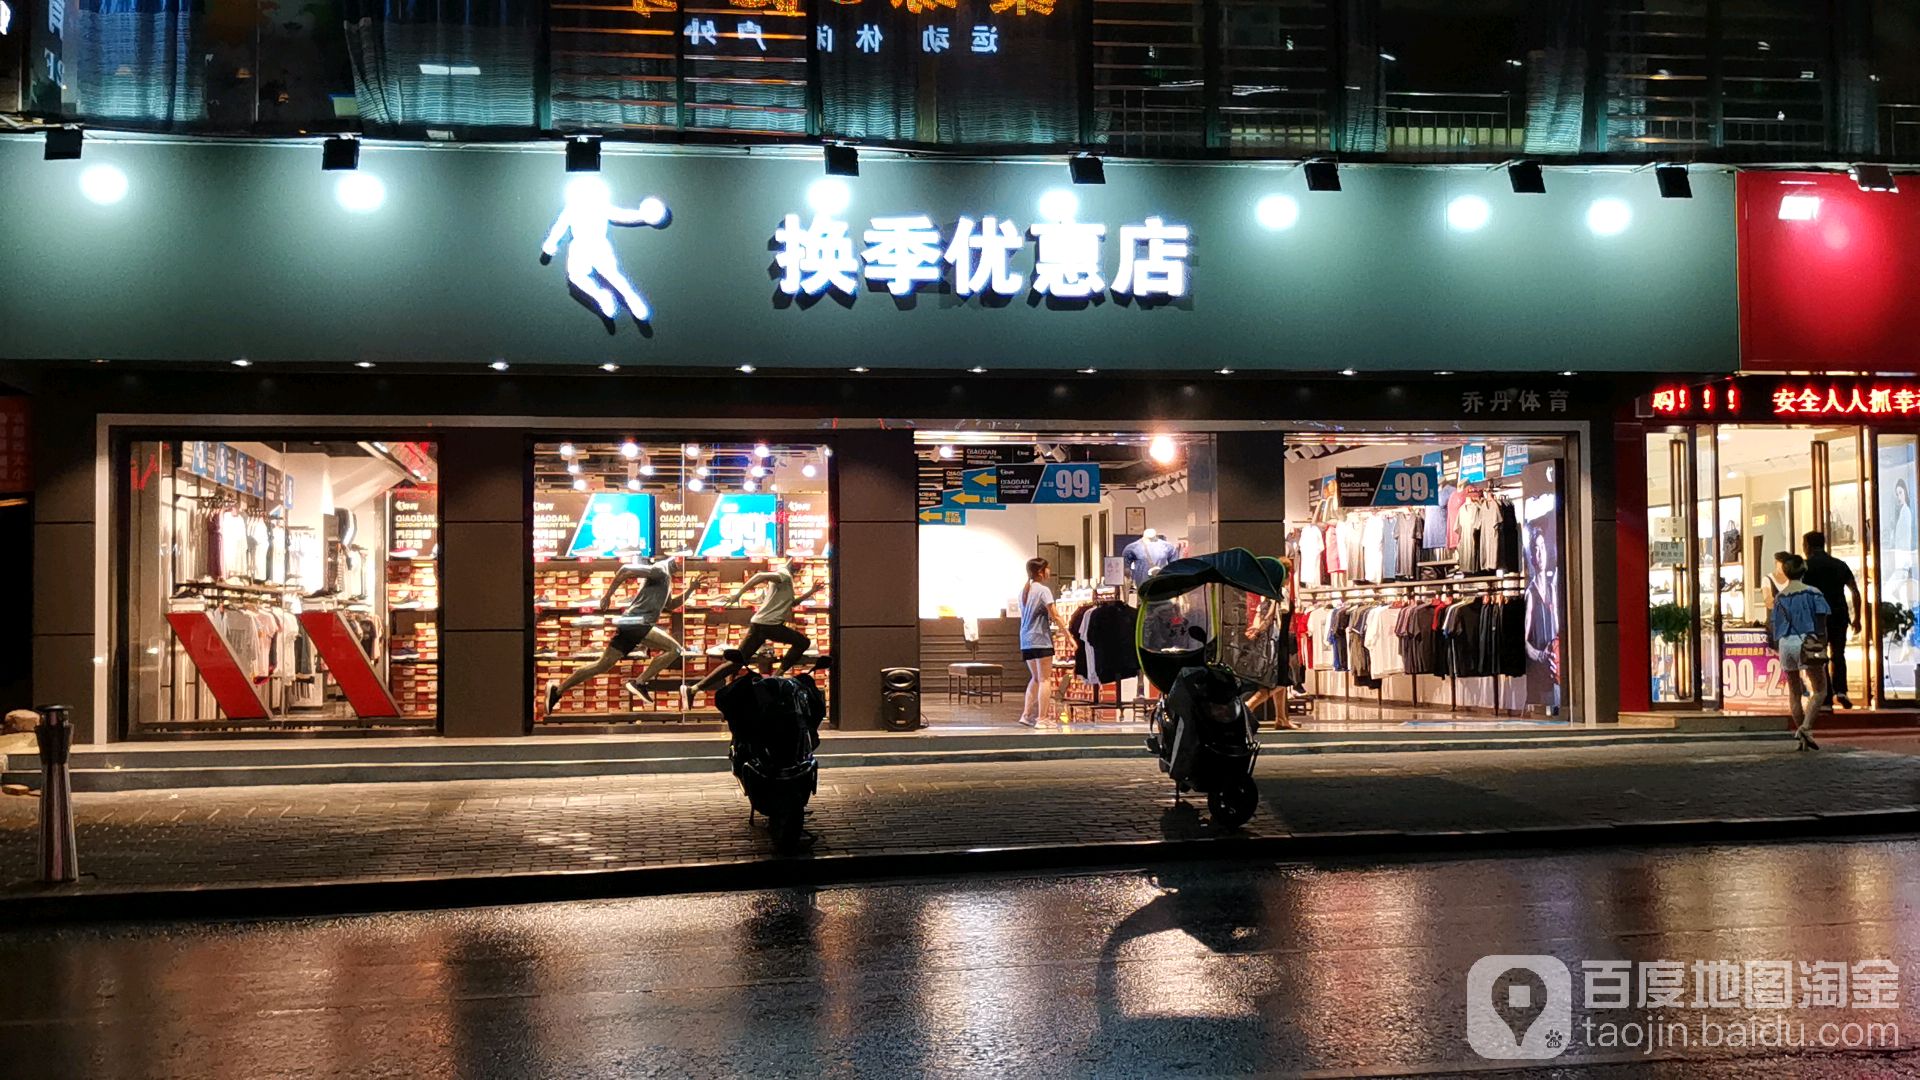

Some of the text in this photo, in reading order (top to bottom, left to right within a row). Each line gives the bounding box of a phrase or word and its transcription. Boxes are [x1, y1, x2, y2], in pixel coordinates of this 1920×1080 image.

[774, 213, 1190, 297] 换季优惠店
[1461, 389, 1570, 413] 乔丹体育
[1772, 388, 1920, 413] 安全人人抓幸
[1055, 469, 1090, 499] 99
[1394, 472, 1429, 501] 99
